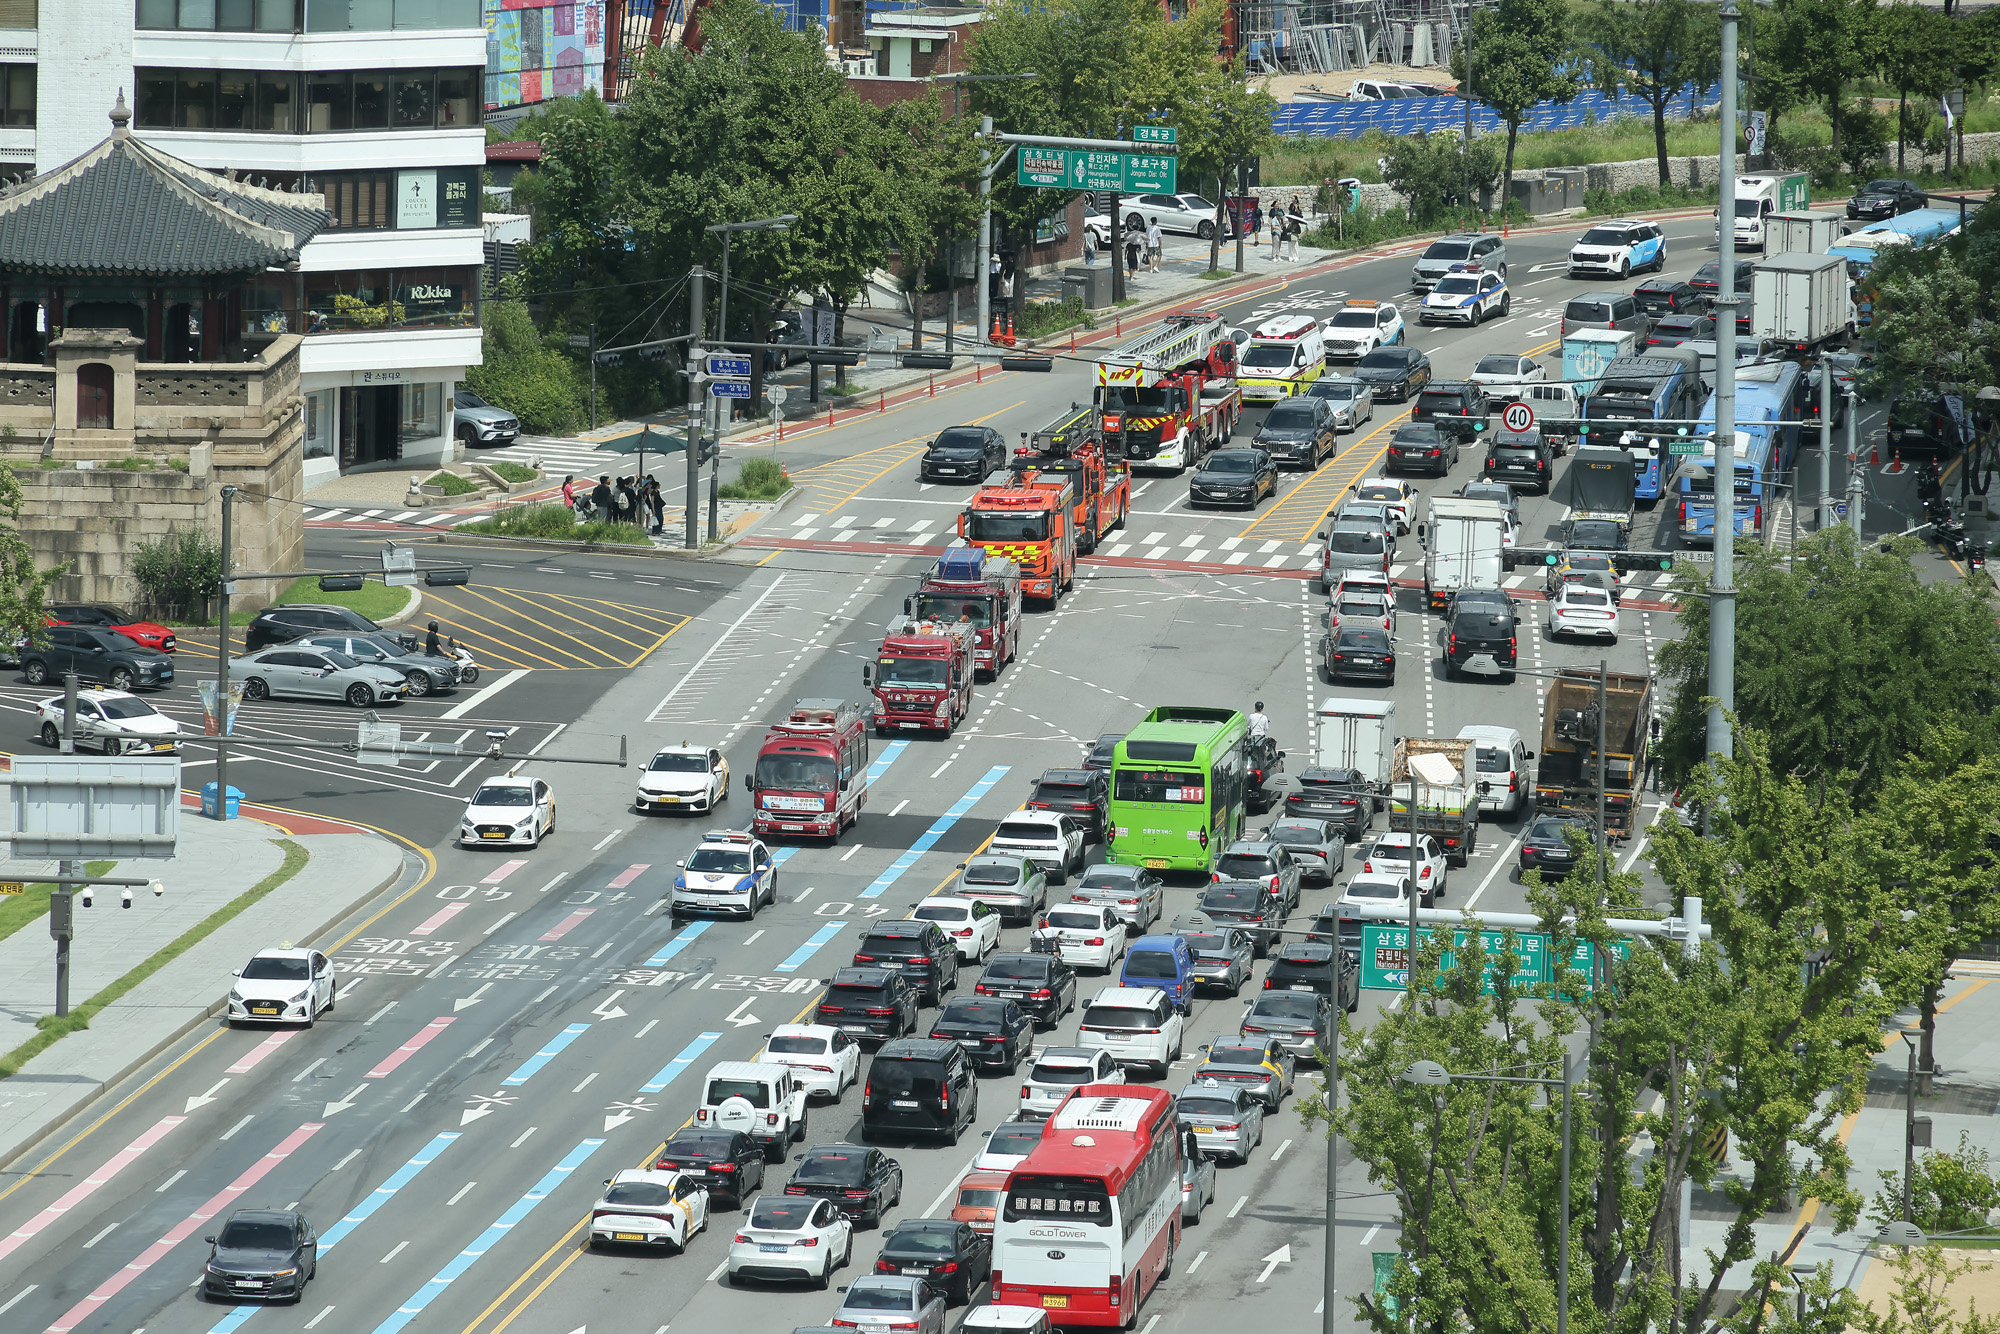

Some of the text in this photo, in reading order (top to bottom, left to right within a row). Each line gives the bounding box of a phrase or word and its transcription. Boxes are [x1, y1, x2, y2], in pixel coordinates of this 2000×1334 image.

[576, 3, 584, 29] THE
[543, 9, 553, 95] COMPLEXITY
[1140, 128, 1170, 140] 경복궁
[1024, 150, 1064, 159] 삼청터널
[1088, 154, 1119, 165] 흥인지문
[1131, 158, 1169, 170] 종로구청
[1130, 169, 1146, 178] Jongno
[446, 182, 466, 191] 경복궁
[1088, 178, 1121, 190] 안국동사거리
[446, 191, 466, 199] 클래식
[364, 372, 401, 382] 란 스튜디오
[1109, 368, 1134, 381] 119
[1508, 409, 1527, 426] 40
[1189, 788, 1203, 799] 11
[436, 885, 512, 902] 40
[813, 902, 890, 918] 40
[342, 938, 460, 957] 효자동
[1377, 961, 1401, 969] National
[710, 973, 822, 994] 세종로
